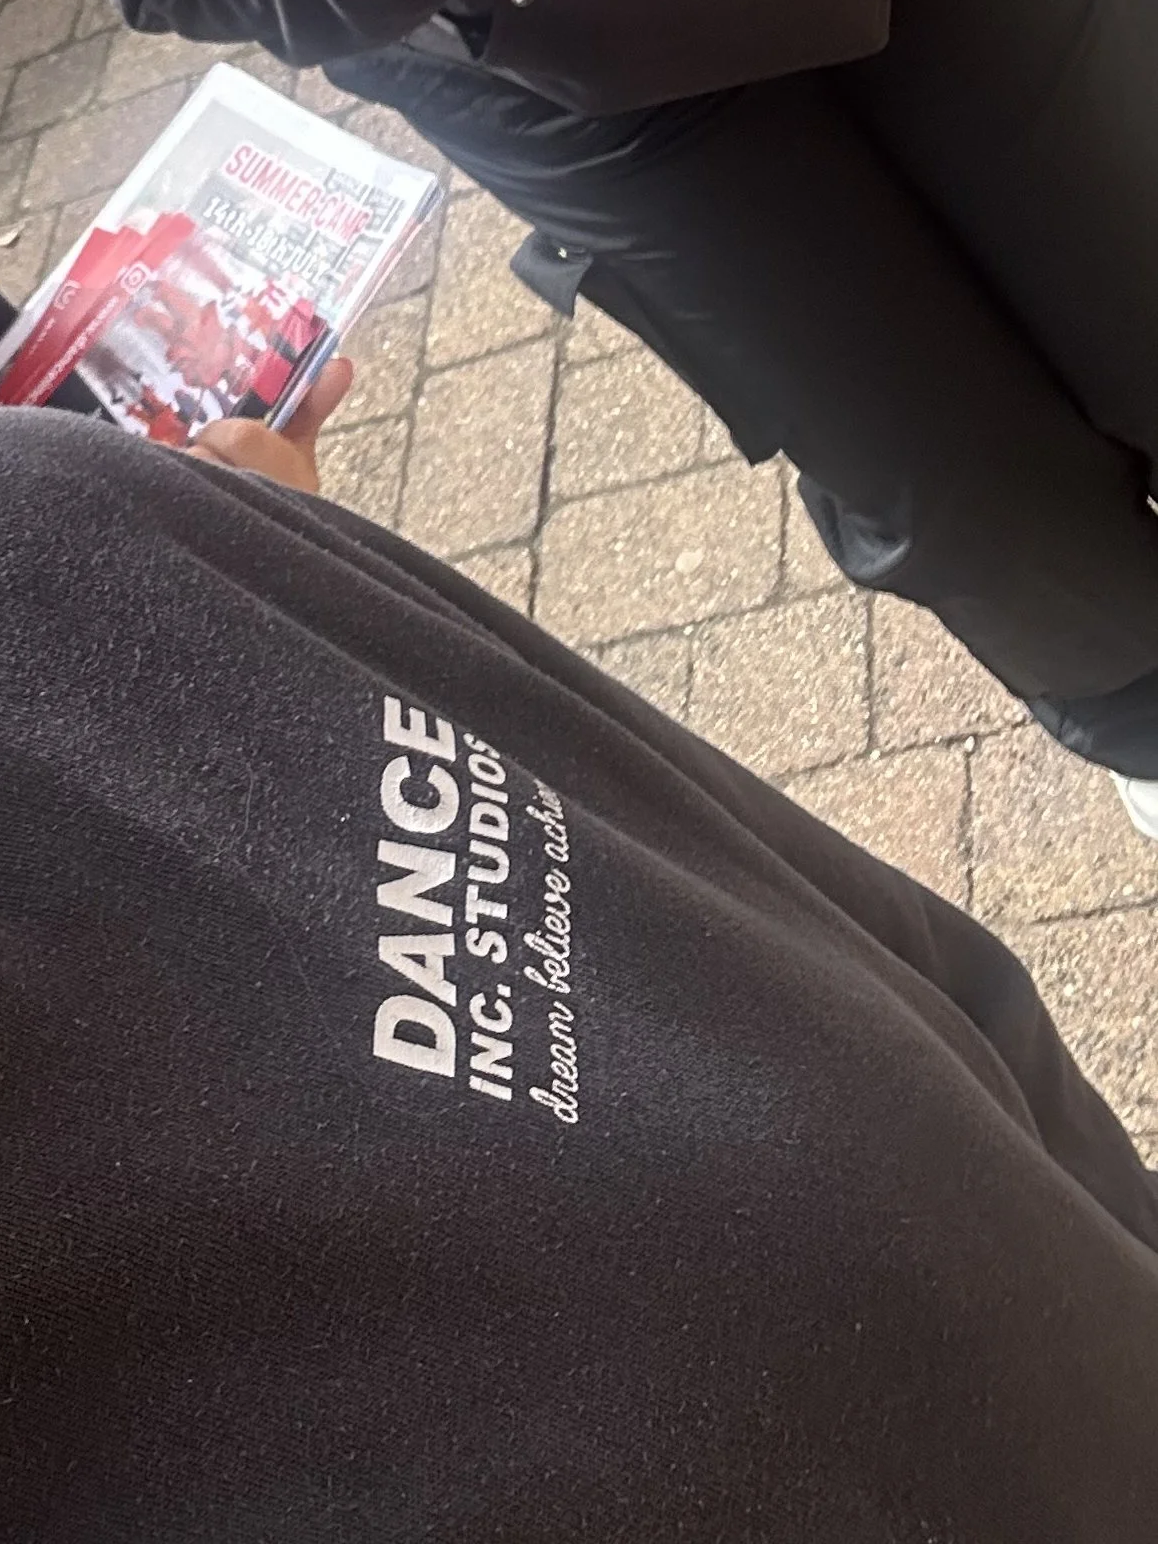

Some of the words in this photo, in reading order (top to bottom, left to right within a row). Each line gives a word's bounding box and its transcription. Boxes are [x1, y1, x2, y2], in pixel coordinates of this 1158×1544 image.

[224, 144, 320, 229] SUMMER
[372, 695, 460, 1077] DANCE
[464, 732, 510, 964] STUDIOS
[523, 868, 572, 994] believe
[469, 983, 513, 1101] INC.
[529, 1001, 580, 1124] dream
